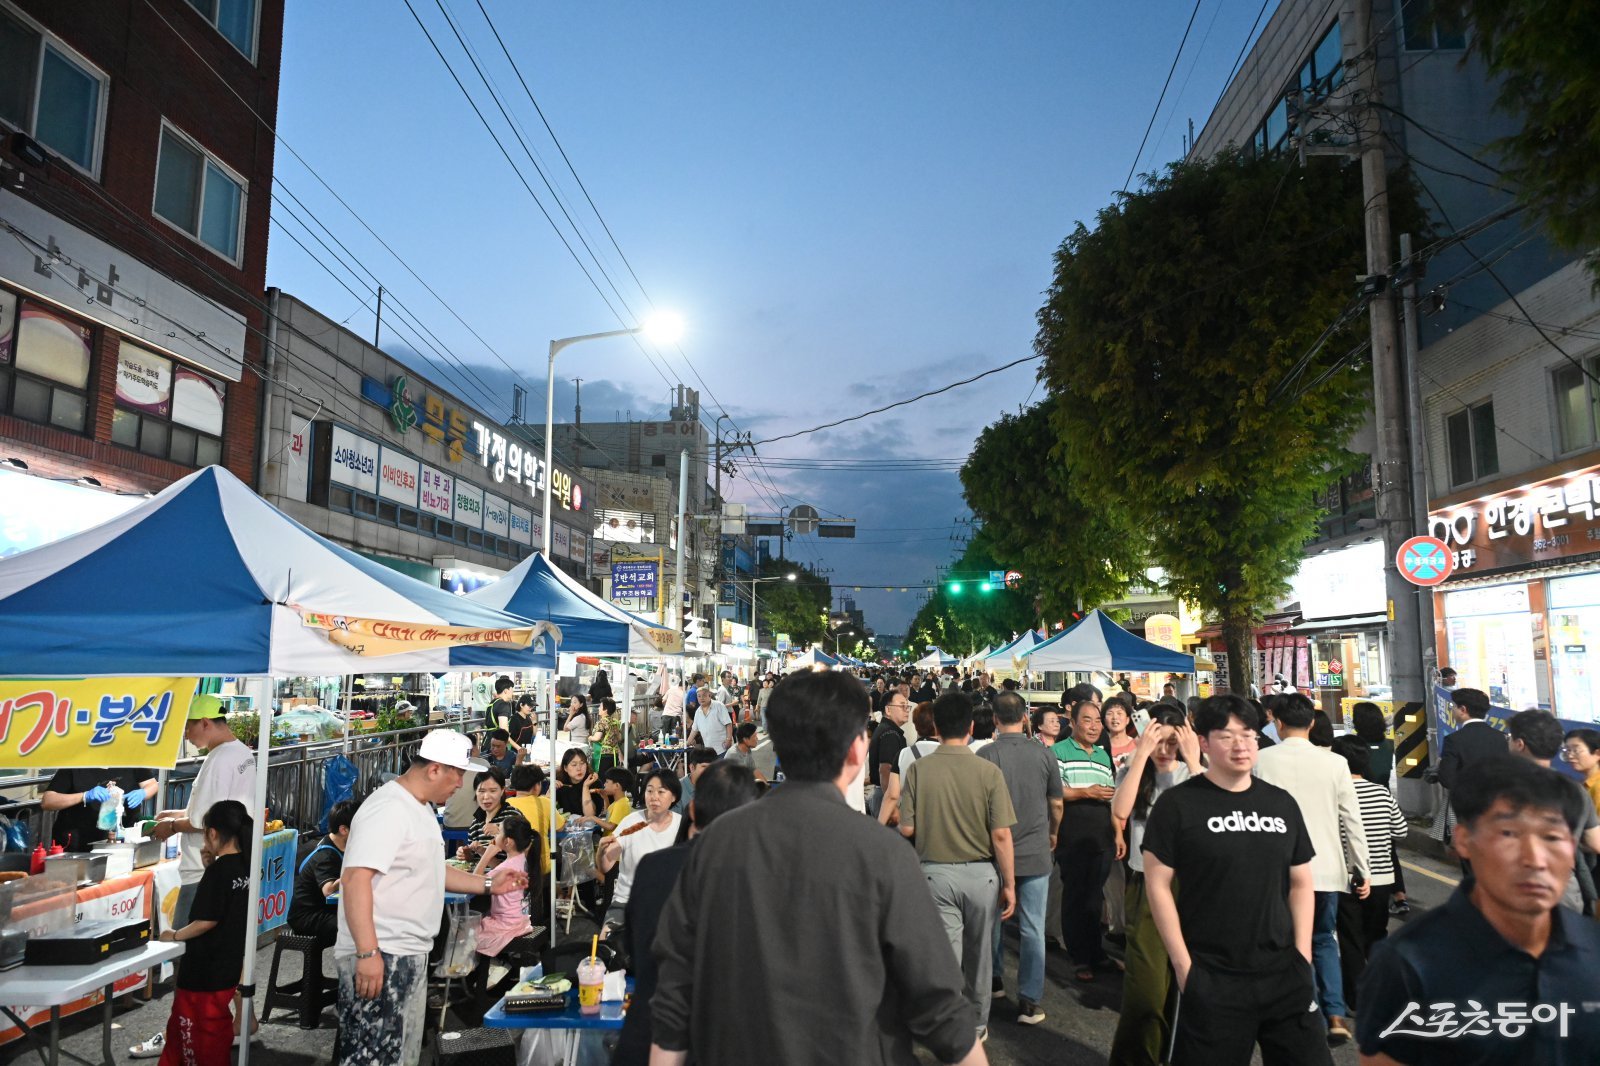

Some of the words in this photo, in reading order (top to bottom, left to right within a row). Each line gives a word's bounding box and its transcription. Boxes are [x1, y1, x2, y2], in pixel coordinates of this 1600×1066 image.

[292, 434, 303, 456] 과
[334, 445, 374, 476] 소아청소년과
[382, 464, 416, 491] 이비인후과
[552, 468, 572, 511] 의원
[422, 490, 450, 514] 비뇨기과
[457, 493, 480, 515] 정형외과
[511, 515, 530, 532] 물리치료
[620, 571, 654, 583] 반석교회
[1207, 810, 1287, 834] adidas
